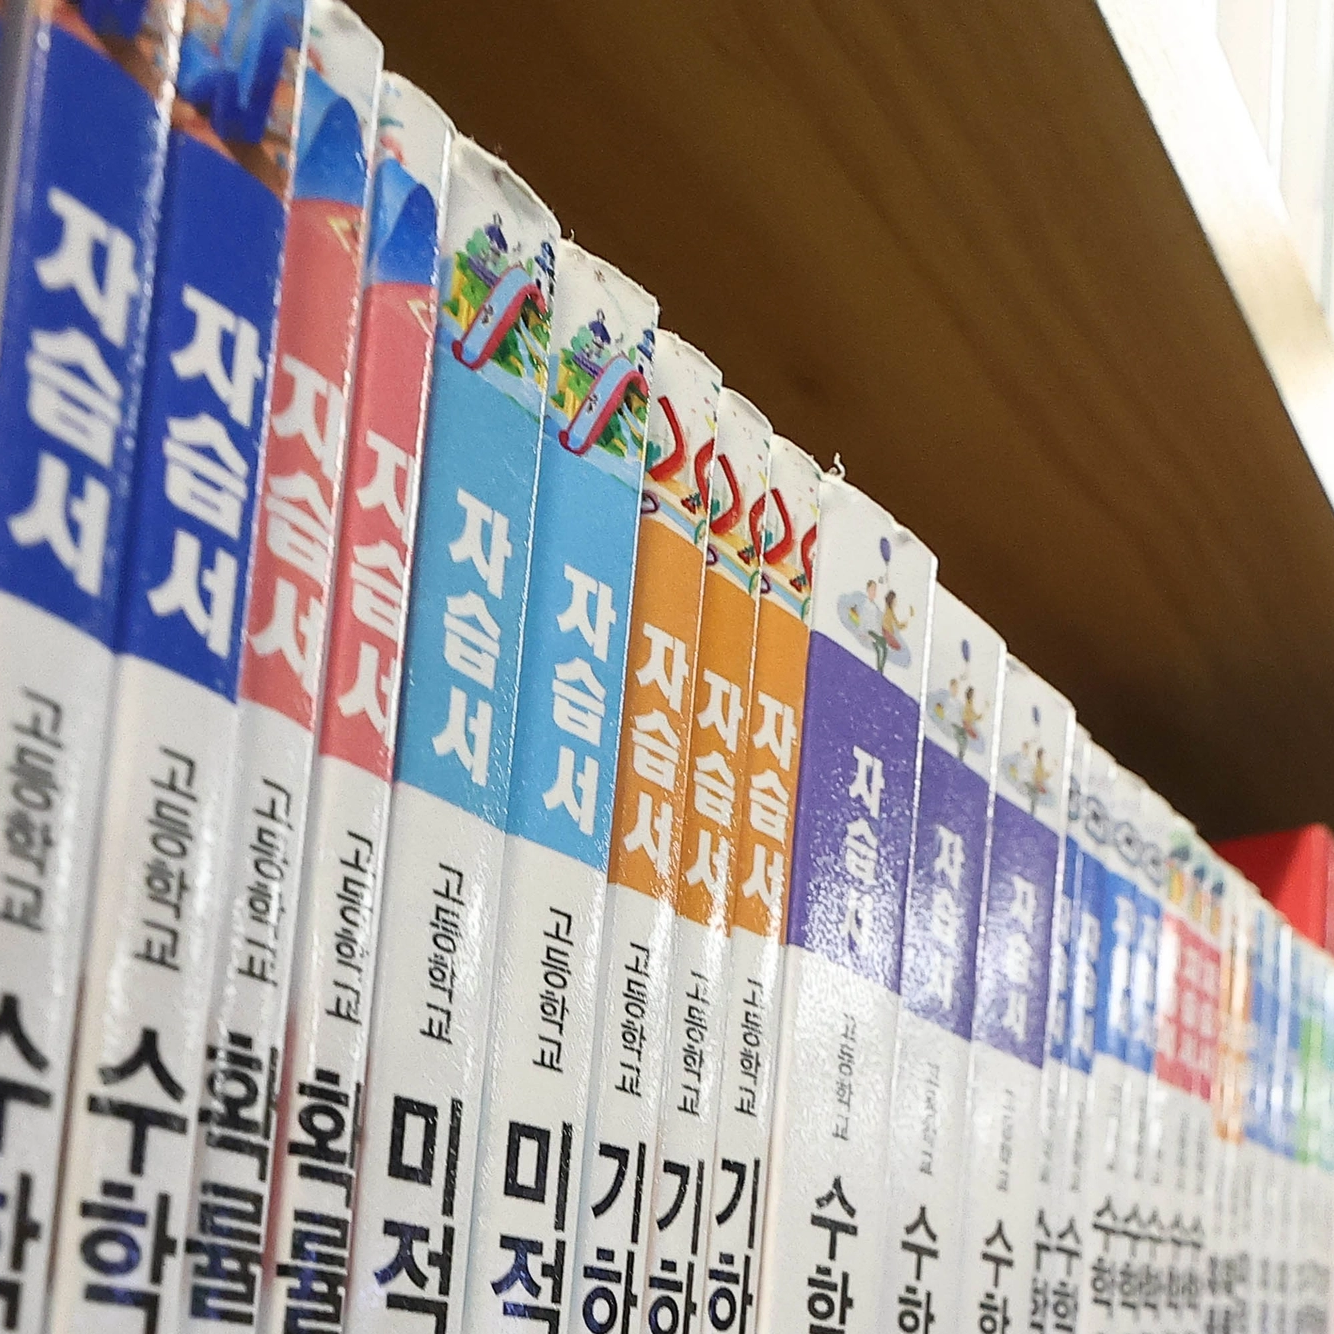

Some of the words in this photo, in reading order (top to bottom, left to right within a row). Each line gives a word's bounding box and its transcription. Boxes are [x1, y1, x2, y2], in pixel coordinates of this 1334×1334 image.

[7, 188, 137, 597] 자습서
[149, 285, 263, 658] 자습서
[248, 354, 347, 686] 자습서
[339, 428, 416, 748] 자습서
[432, 488, 513, 788] 자습서
[544, 565, 617, 836] 자습서
[622, 622, 689, 877] 자습서
[134, 748, 198, 971] 고등학교
[238, 776, 292, 986] 고등학교
[685, 666, 743, 893] 자습서
[742, 689, 798, 905] 자습서
[325, 830, 373, 1027] 고등학교
[420, 862, 463, 1044] 고등학교
[532, 905, 572, 1073] 고등학교
[615, 941, 649, 1098] 고등학교
[677, 968, 708, 1117] 고등학교
[734, 977, 763, 1118] 고등학교
